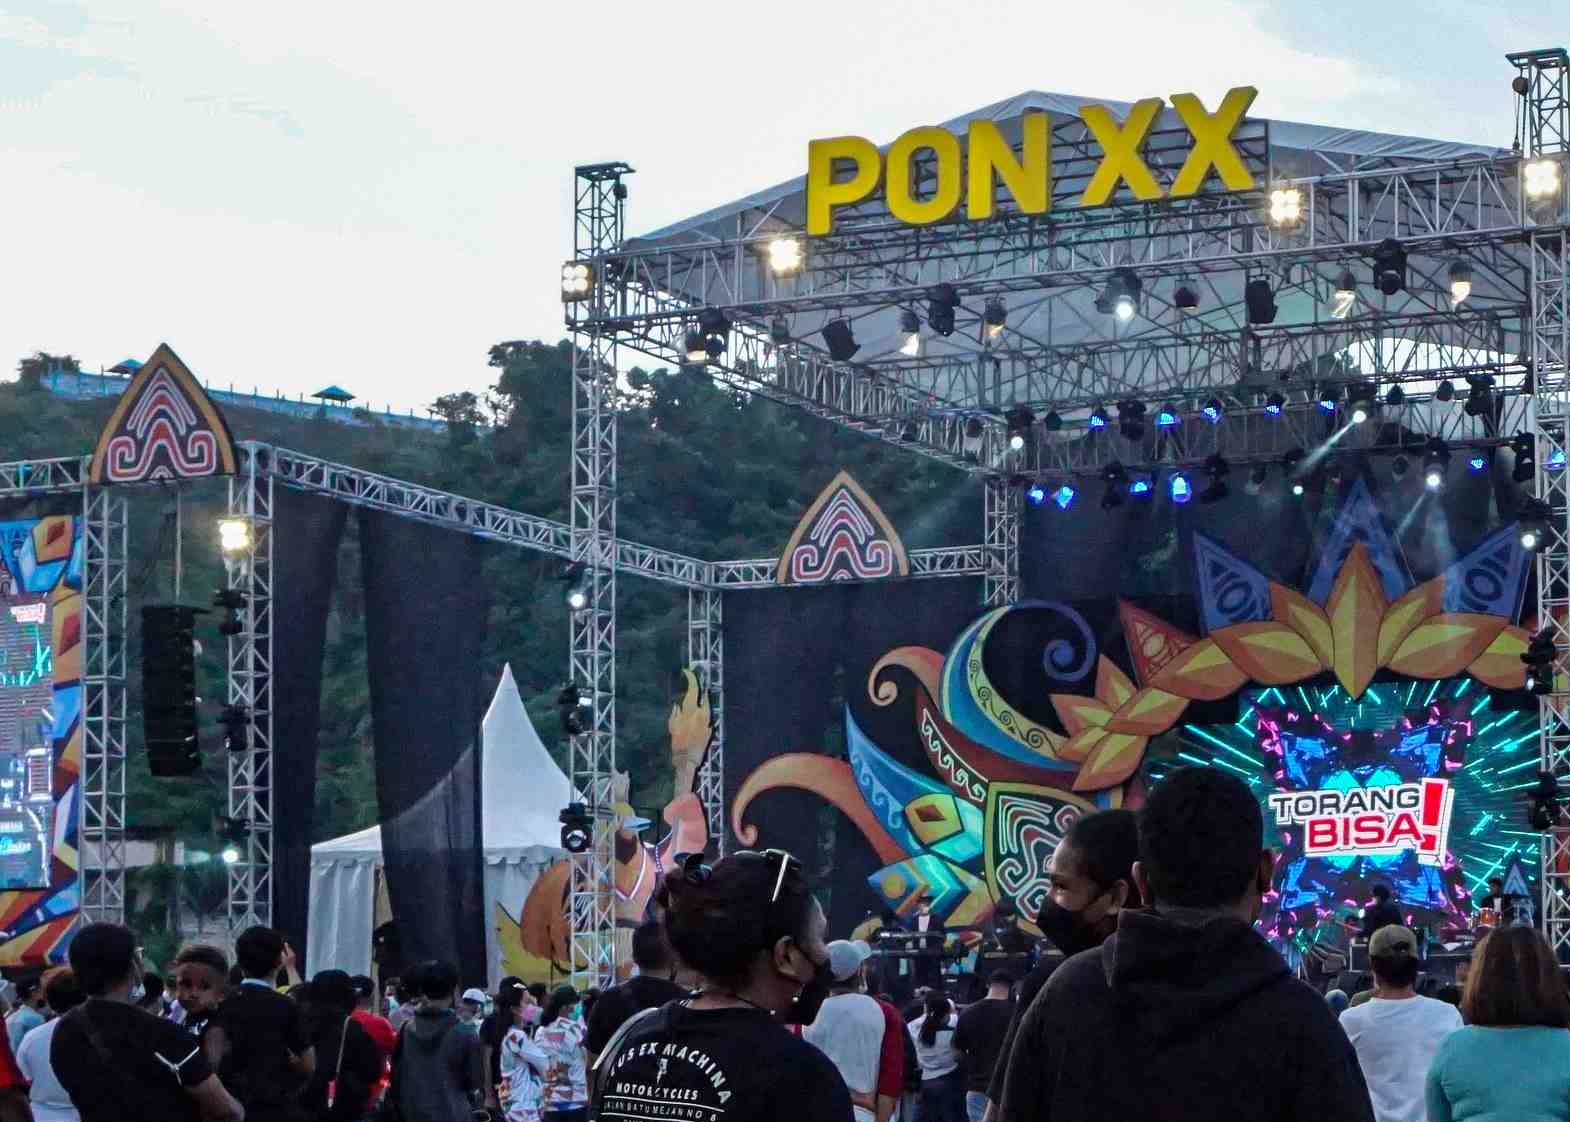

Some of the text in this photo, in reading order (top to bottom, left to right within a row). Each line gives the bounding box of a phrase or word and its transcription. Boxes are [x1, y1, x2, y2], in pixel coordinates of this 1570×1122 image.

[806, 86, 1258, 236] PON XX
[1272, 786, 1420, 818] TORANG
[615, 1082, 699, 1101] MOTORCYCLES
[662, 1043, 732, 1104] MACHINA
